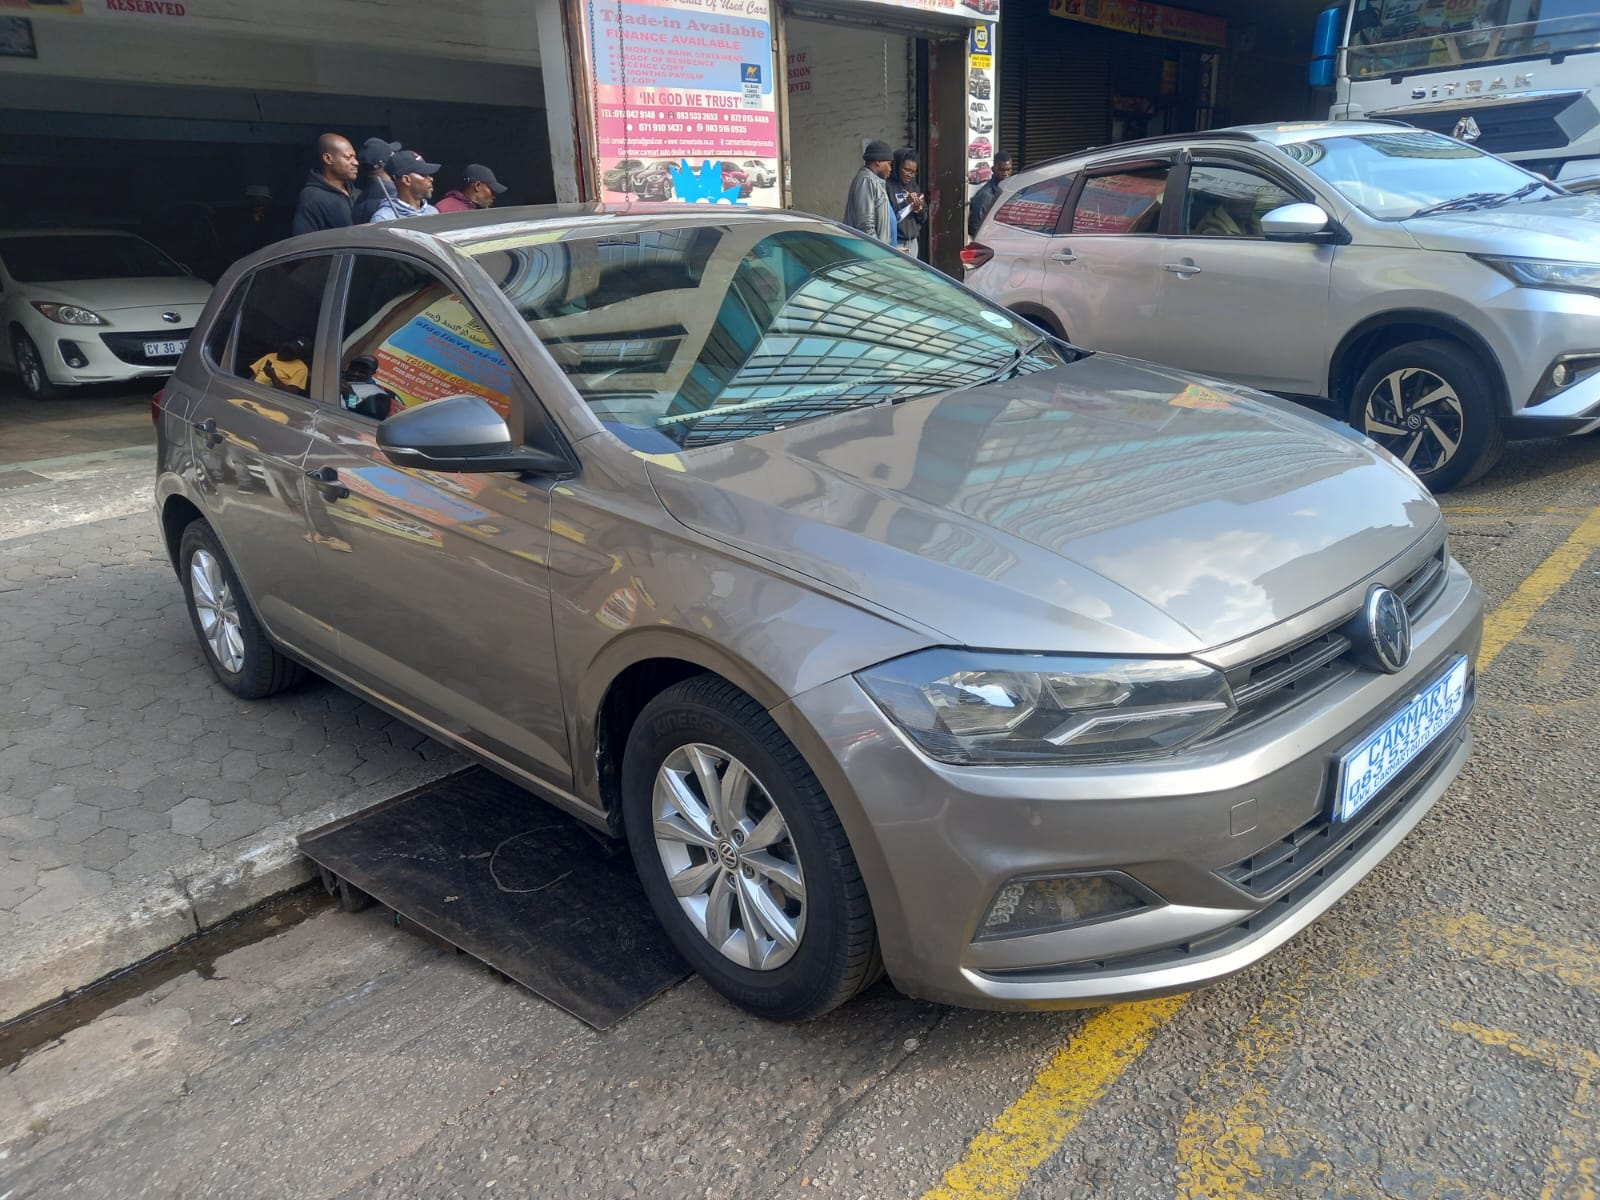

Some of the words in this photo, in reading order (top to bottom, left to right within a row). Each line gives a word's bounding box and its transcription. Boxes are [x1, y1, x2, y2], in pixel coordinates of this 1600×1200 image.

[106, 0, 186, 16] RESERVED
[721, 0, 744, 11] Used
[746, 1, 768, 15] Cars
[600, 9, 681, 29] Trade-in
[688, 18, 765, 38] Available
[606, 28, 668, 42] FINANCE
[672, 35, 742, 50] AVAILABLE
[797, 52, 806, 62] OF
[1412, 73, 1534, 100] SITRAK
[659, 93, 682, 106] GOD
[685, 94, 702, 106] WE
[148, 342, 159, 354] CY
[163, 342, 176, 354] 30
[1368, 676, 1452, 767] CARMART
[1349, 757, 1384, 802] 083
[1389, 724, 1421, 764] 533
[1425, 685, 1462, 731] 3653
